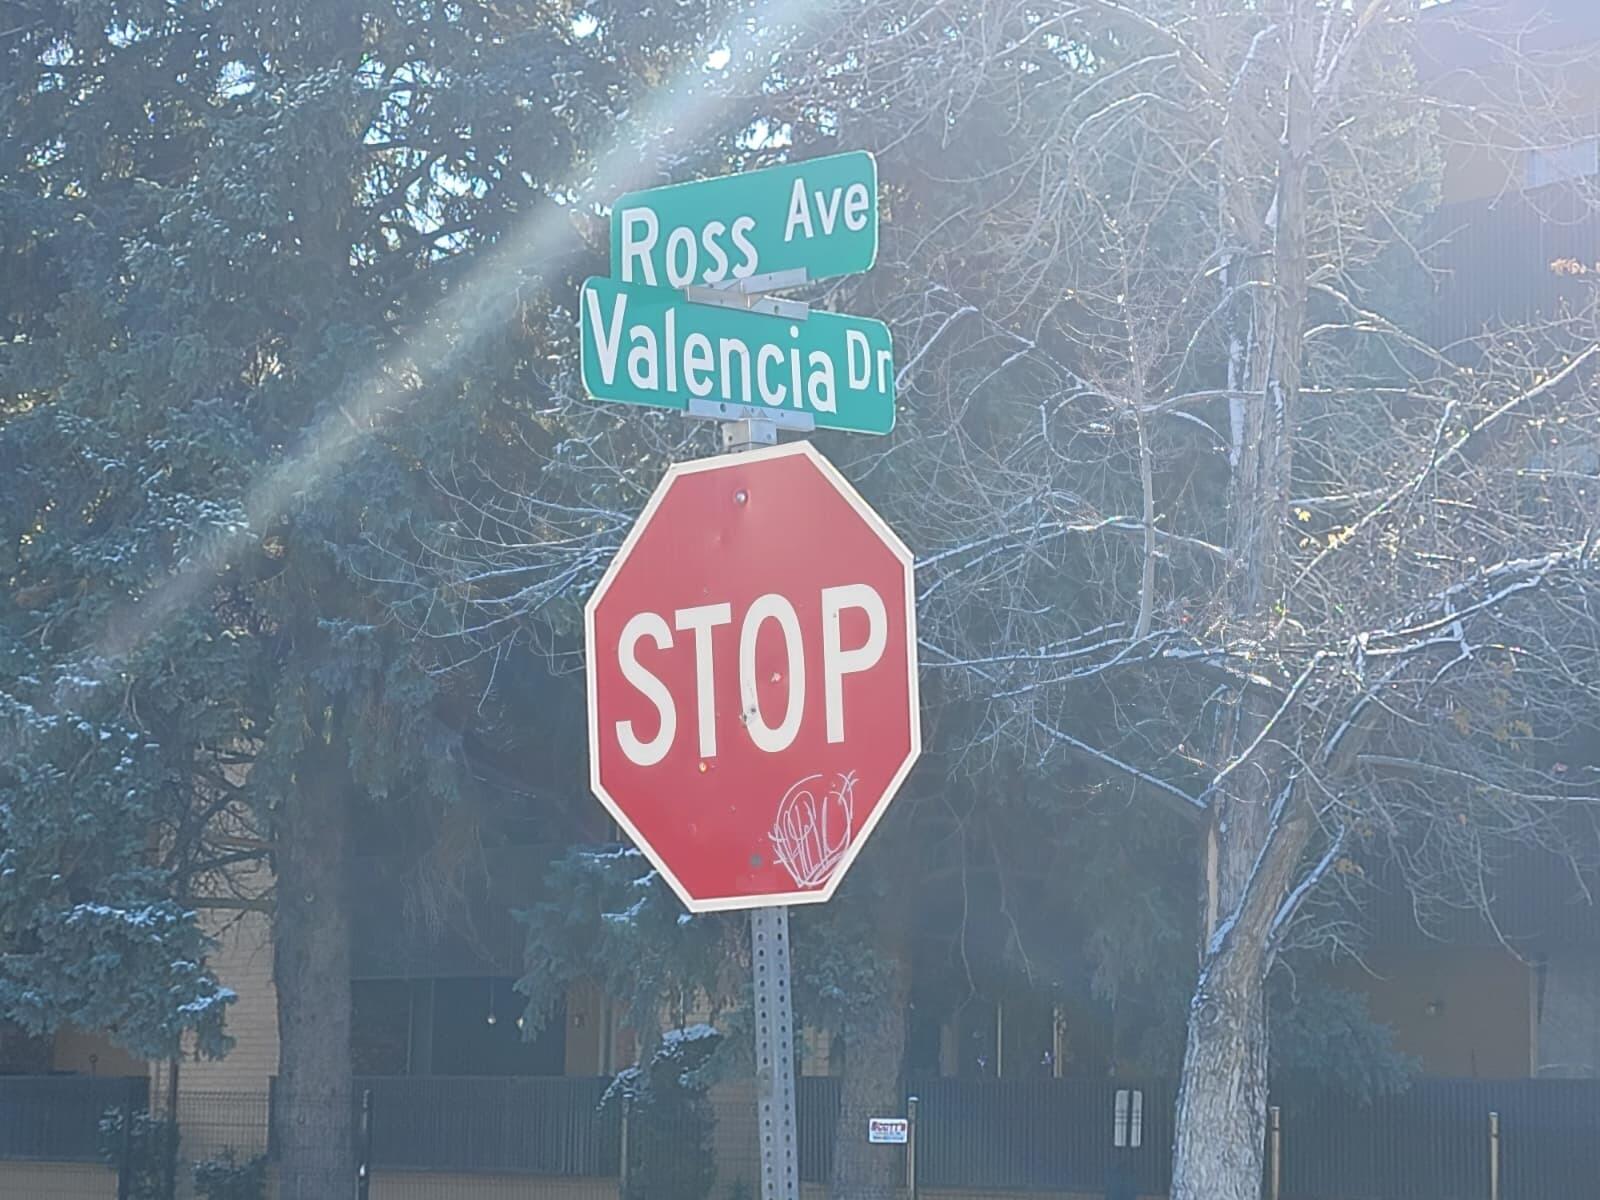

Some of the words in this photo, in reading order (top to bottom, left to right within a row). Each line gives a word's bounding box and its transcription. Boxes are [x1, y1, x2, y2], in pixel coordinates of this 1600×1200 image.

[621, 206, 759, 289] Ross
[784, 178, 869, 242] Ave
[586, 288, 838, 415] Valencia
[846, 329, 892, 394] Dr
[615, 583, 888, 766] STOP
